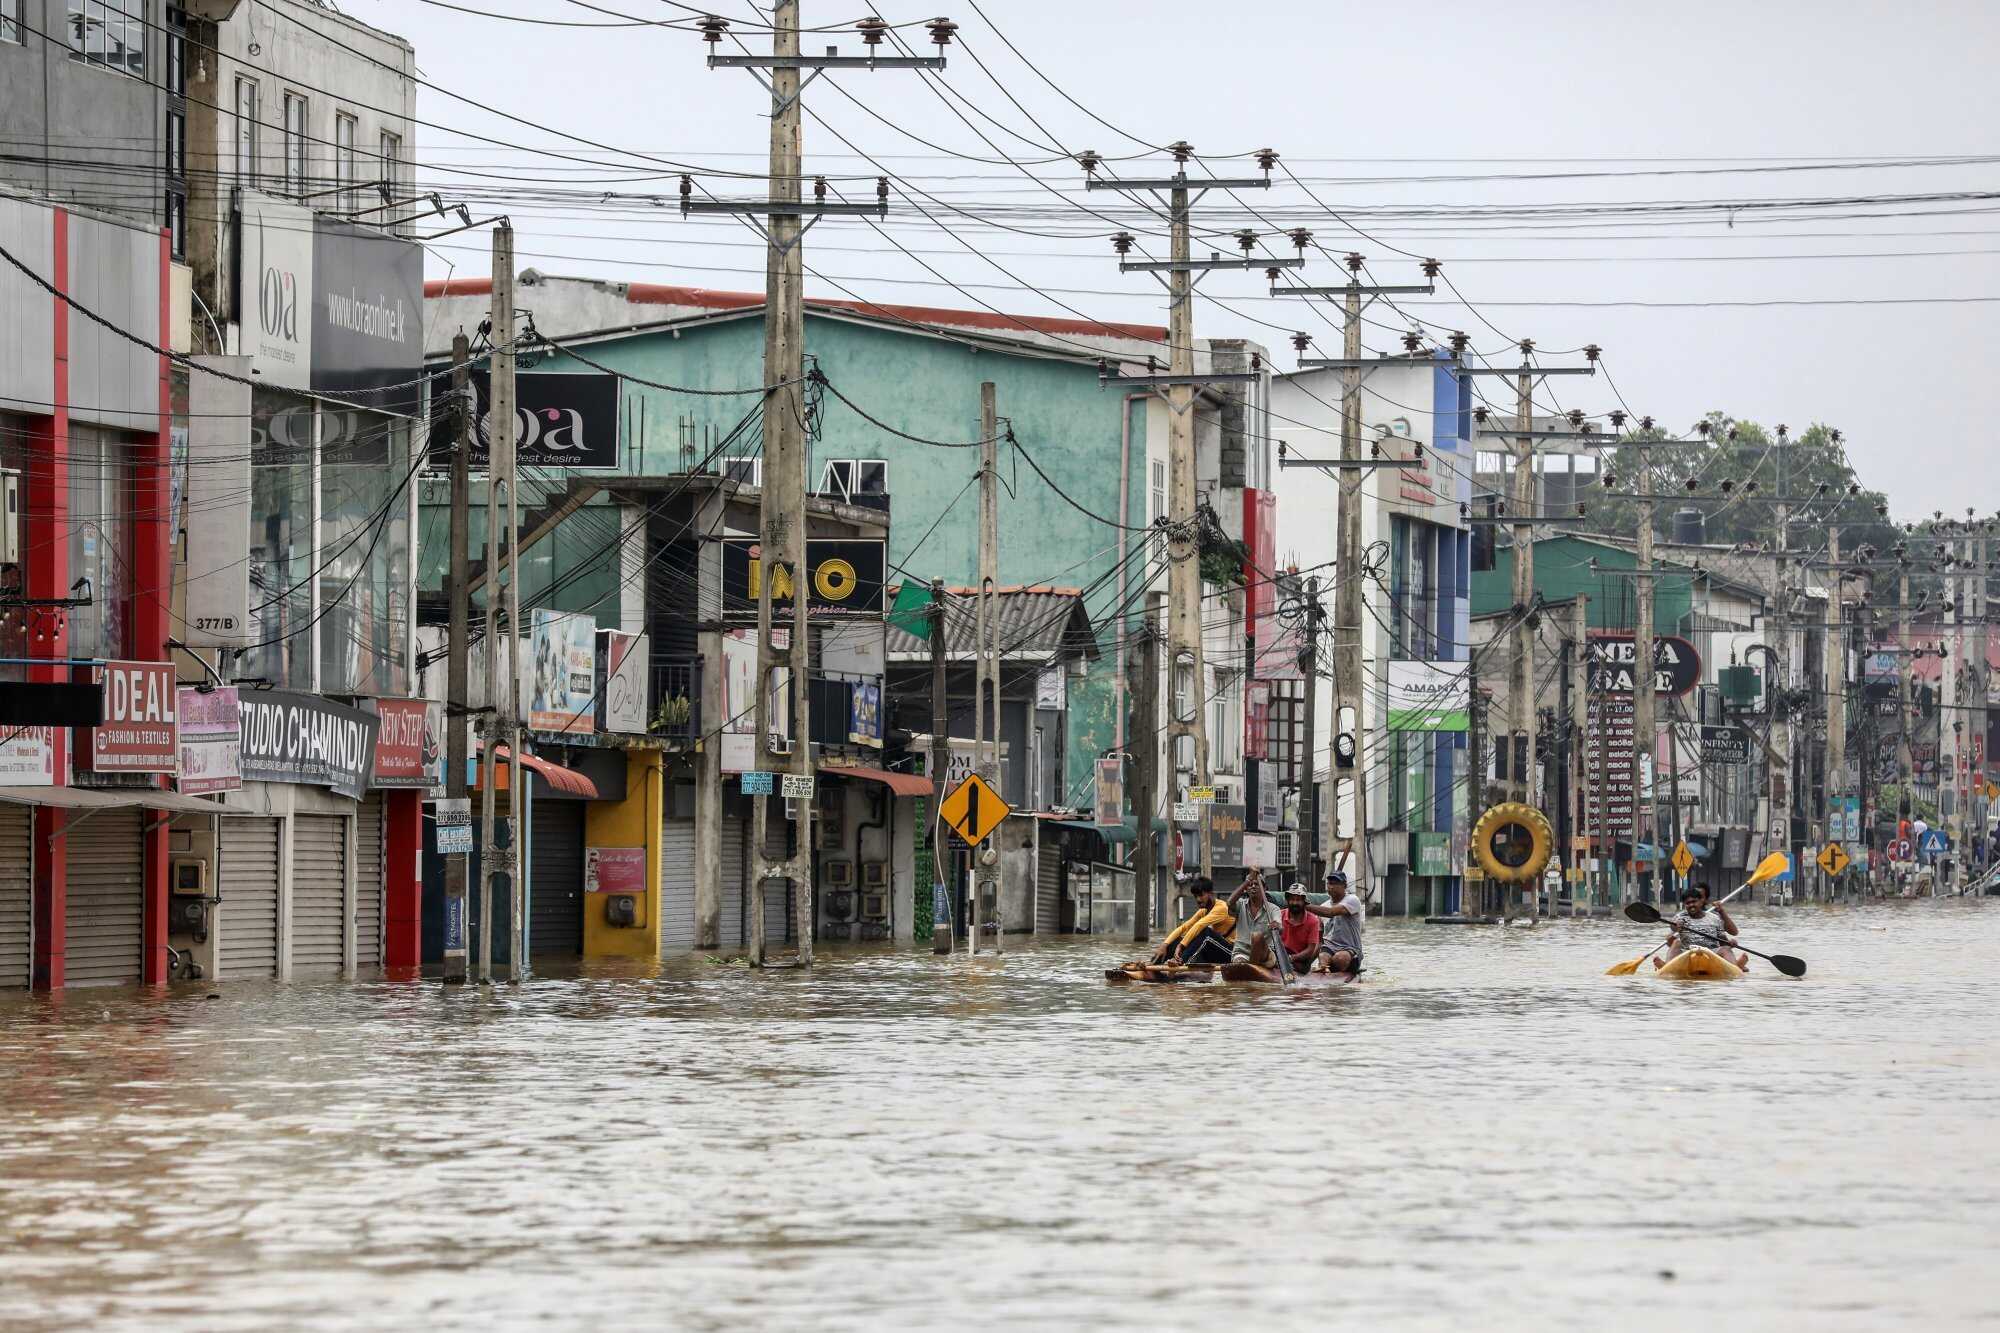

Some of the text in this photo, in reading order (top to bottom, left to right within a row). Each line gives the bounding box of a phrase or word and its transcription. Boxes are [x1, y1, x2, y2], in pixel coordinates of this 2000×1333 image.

[258, 208, 298, 343] lora
[328, 288, 405, 343] www.loraonline.lk
[543, 453, 582, 464] desire
[196, 617, 233, 631] 377/B
[1593, 642, 1680, 664] MEA
[1595, 669, 1675, 691] SAE
[108, 730, 135, 745] FASHION
[142, 731, 170, 745] TEXTILES
[377, 707, 422, 747] NEW STEP
[287, 706, 369, 774] CHAMINDU
